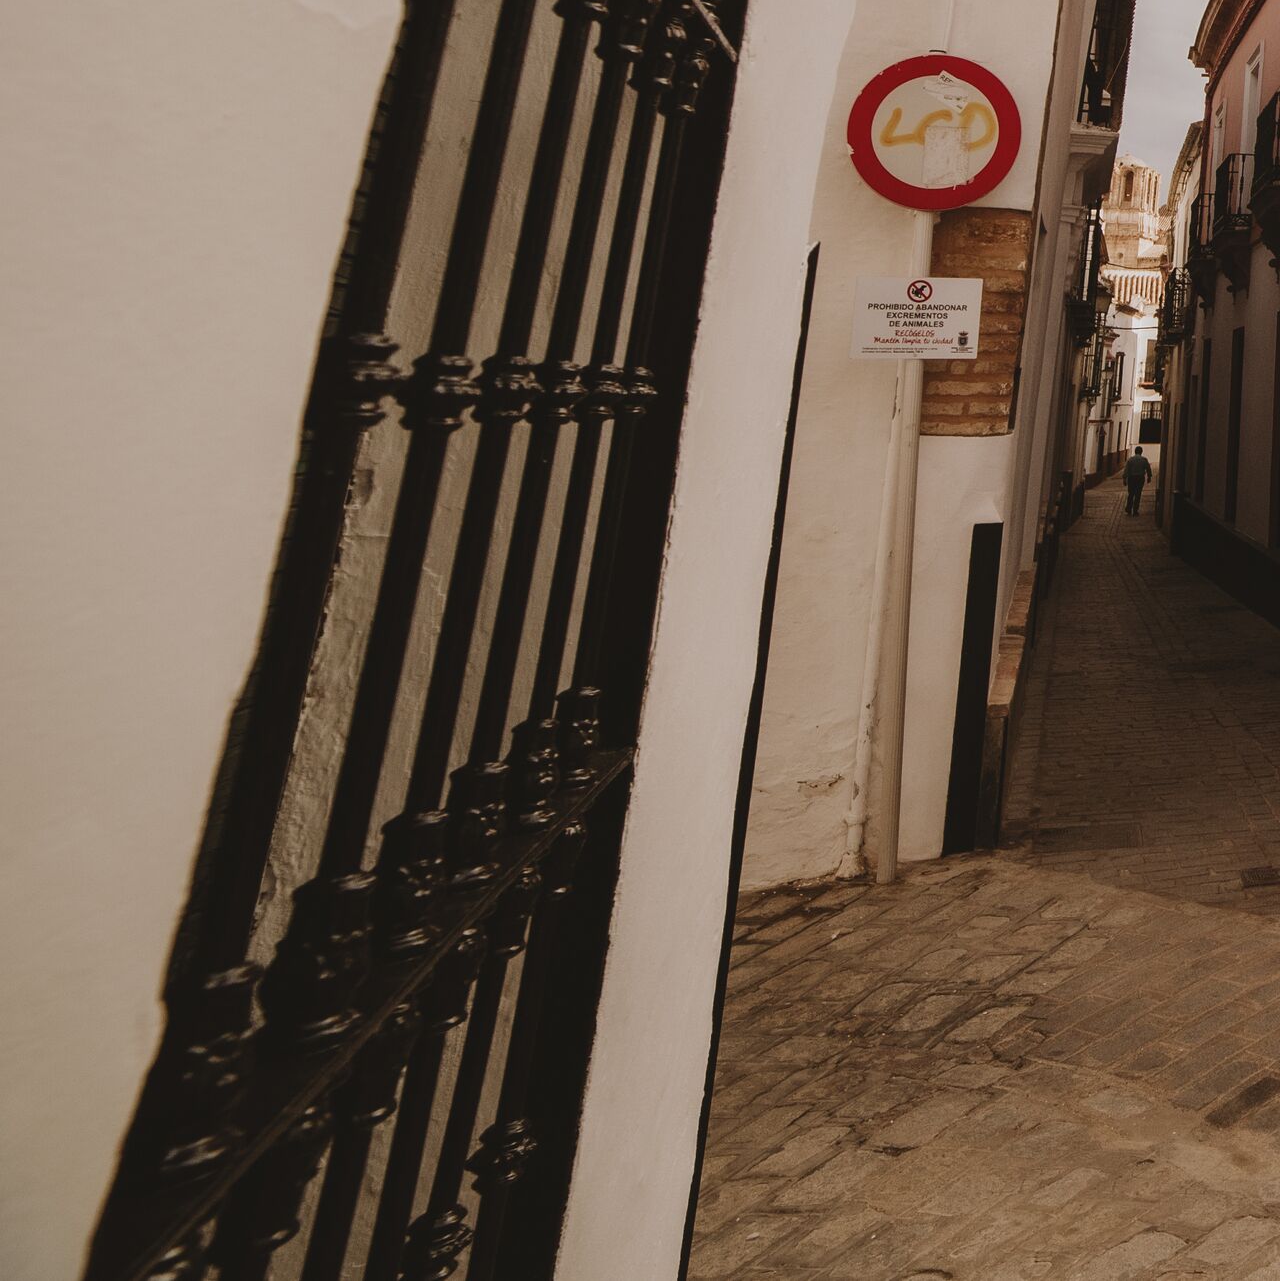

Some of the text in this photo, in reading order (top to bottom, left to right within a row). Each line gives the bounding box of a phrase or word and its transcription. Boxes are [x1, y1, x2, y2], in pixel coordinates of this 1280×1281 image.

[867, 303, 914, 311] PROHIBIDO
[902, 320, 945, 328] ANIMALES
[901, 337, 922, 345] limpia
